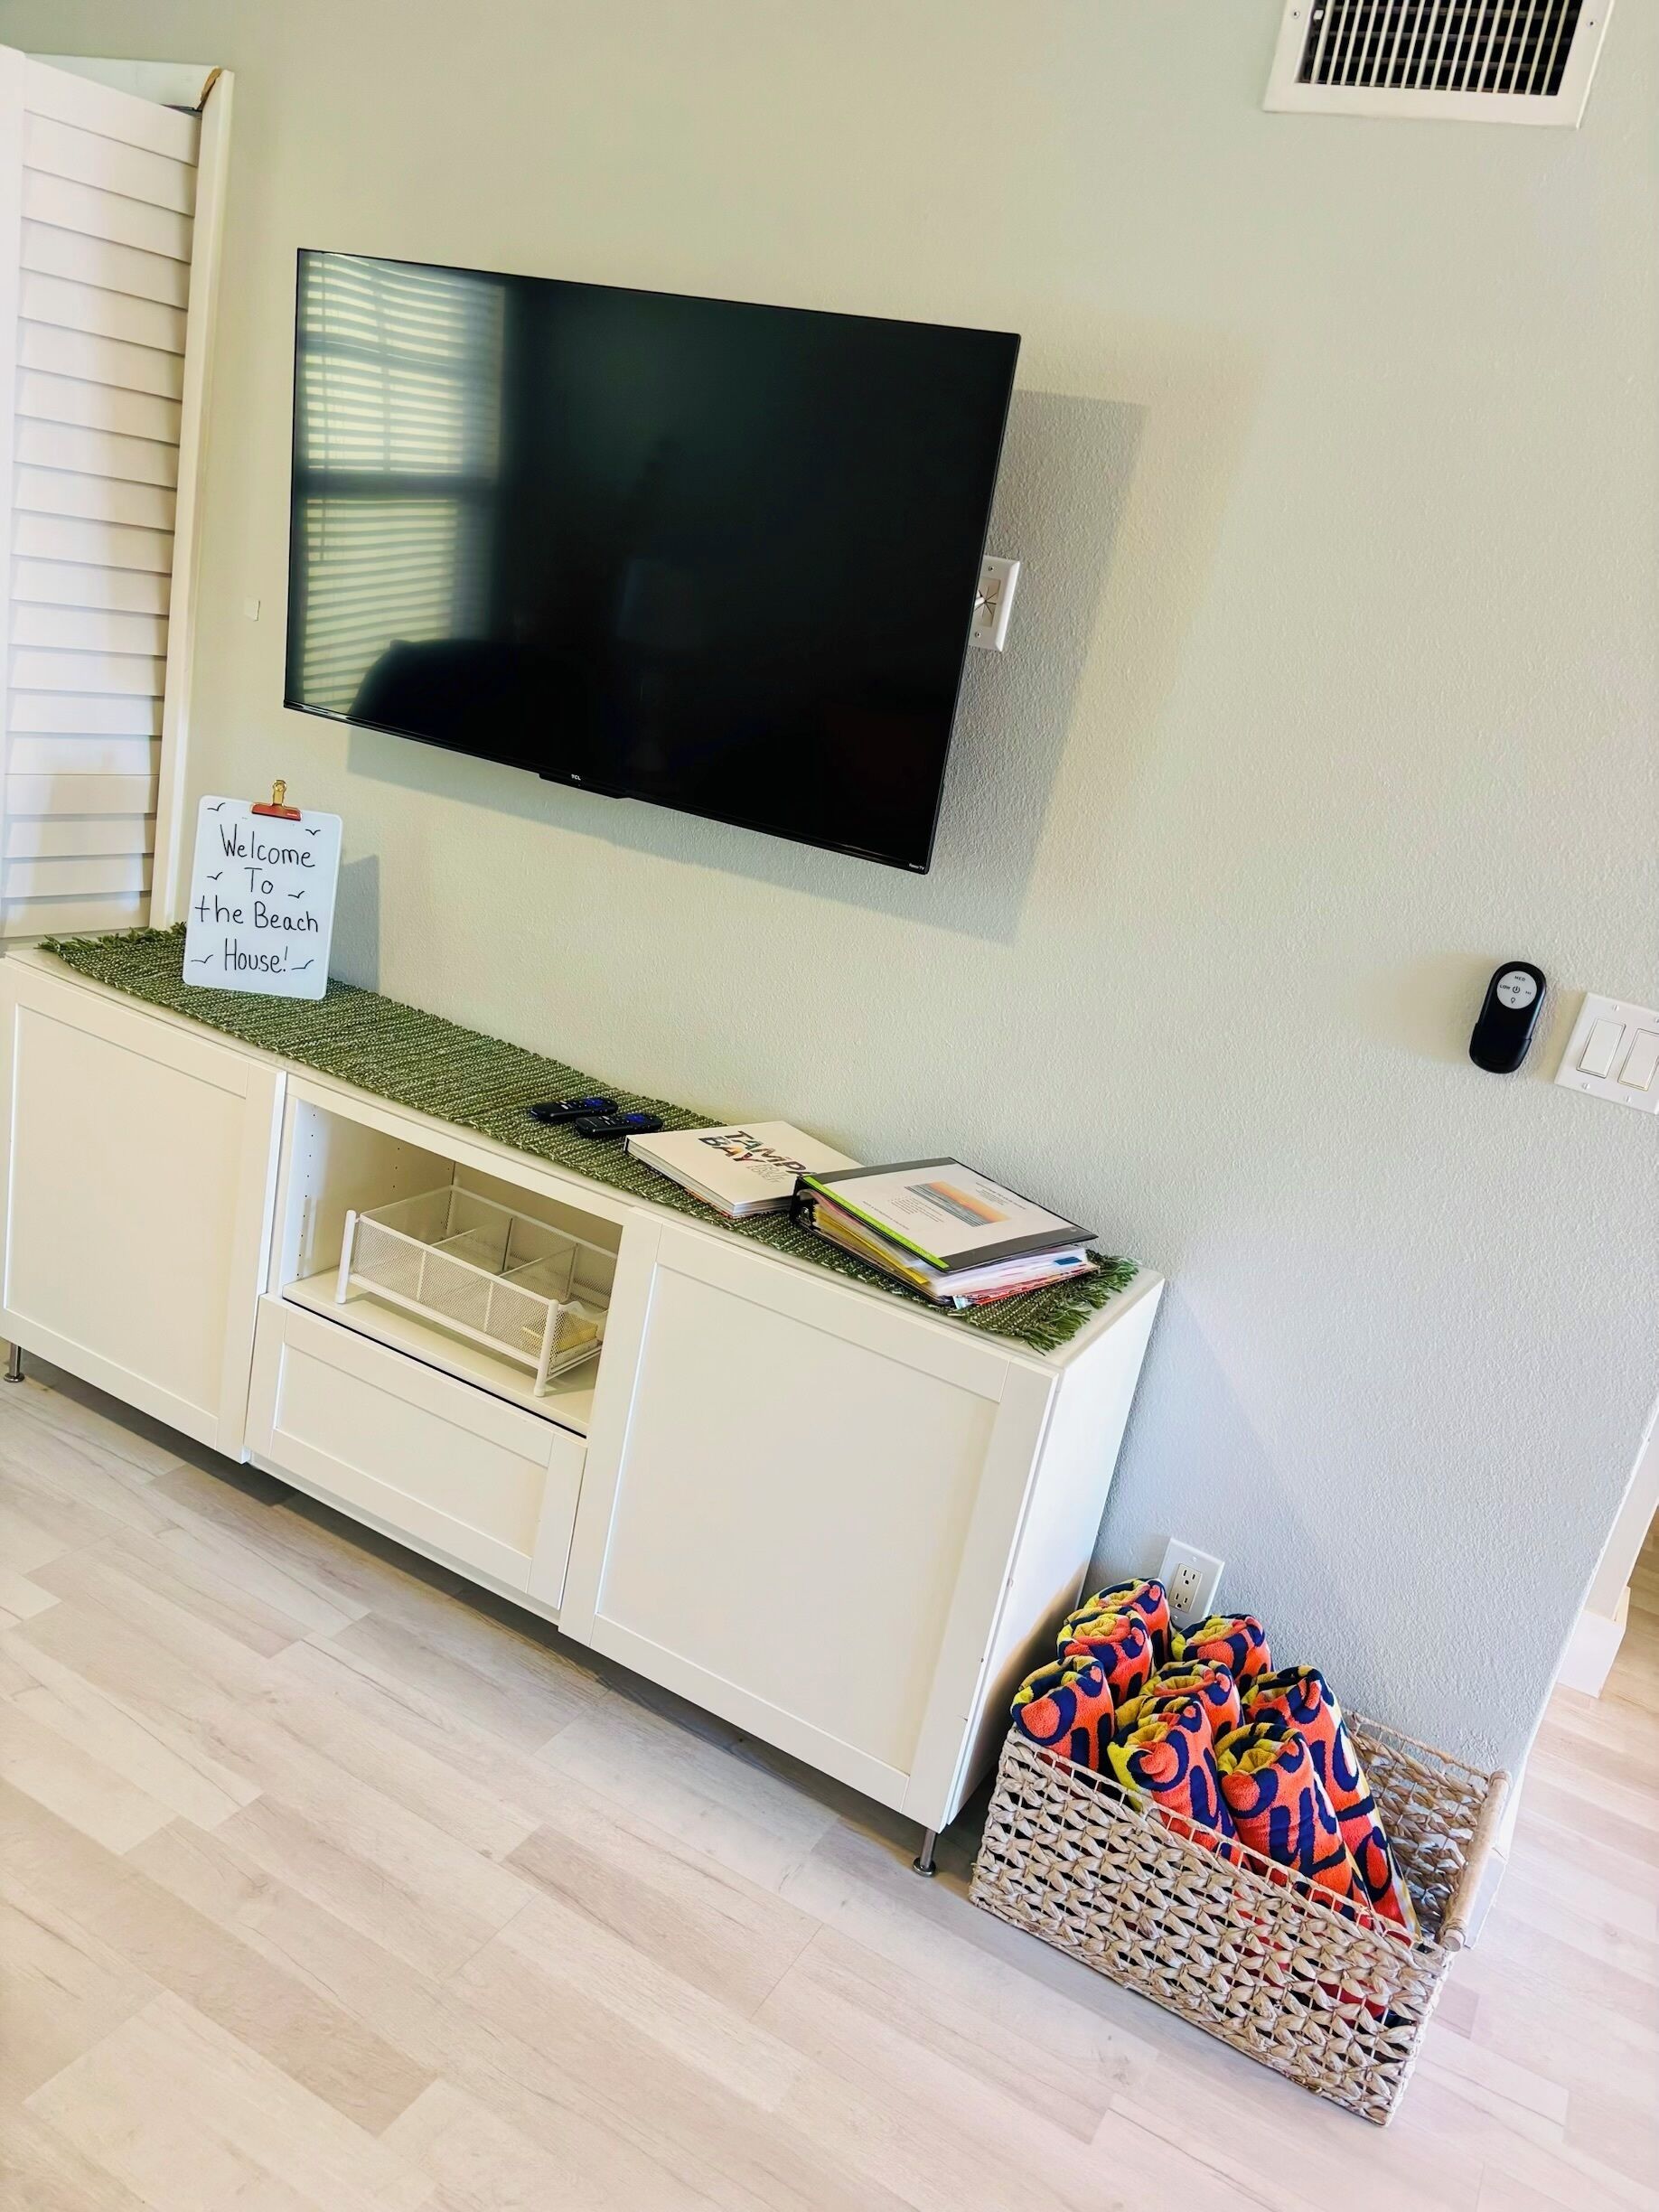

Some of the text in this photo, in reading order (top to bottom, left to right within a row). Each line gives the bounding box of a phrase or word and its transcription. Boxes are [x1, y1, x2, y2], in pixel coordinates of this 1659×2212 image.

[220, 823, 315, 868] Welcome
[244, 867, 274, 895] To
[194, 895, 319, 933] the Beach
[224, 937, 288, 973] House!
[698, 1136, 766, 1162] BAY
